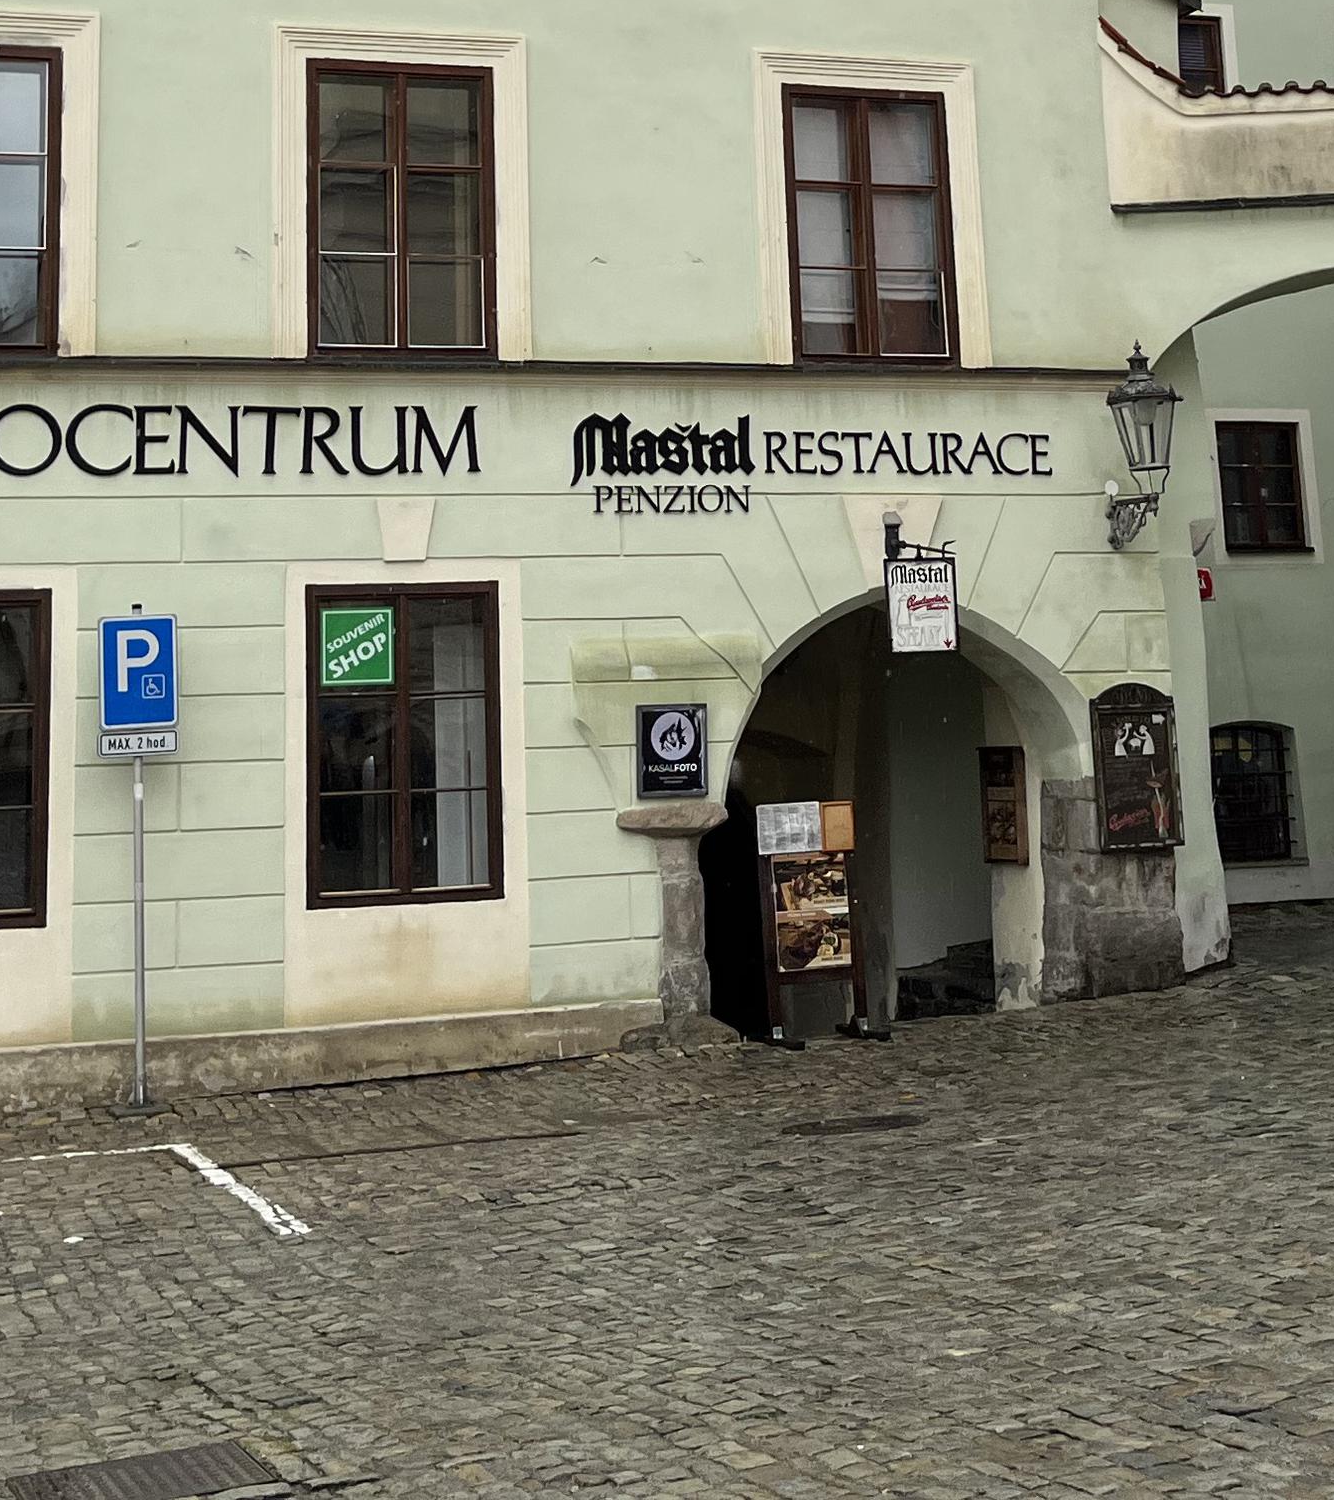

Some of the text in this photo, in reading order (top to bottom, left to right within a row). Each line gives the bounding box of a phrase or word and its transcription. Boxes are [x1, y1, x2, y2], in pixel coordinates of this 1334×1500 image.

[569, 412, 1053, 487] Maštal RESTAURACE
[592, 484, 751, 514] PENZION
[326, 613, 386, 653] SOUVENIR
[116, 629, 160, 693] P
[328, 632, 387, 679] SHOP
[137, 736, 143, 749] 2
